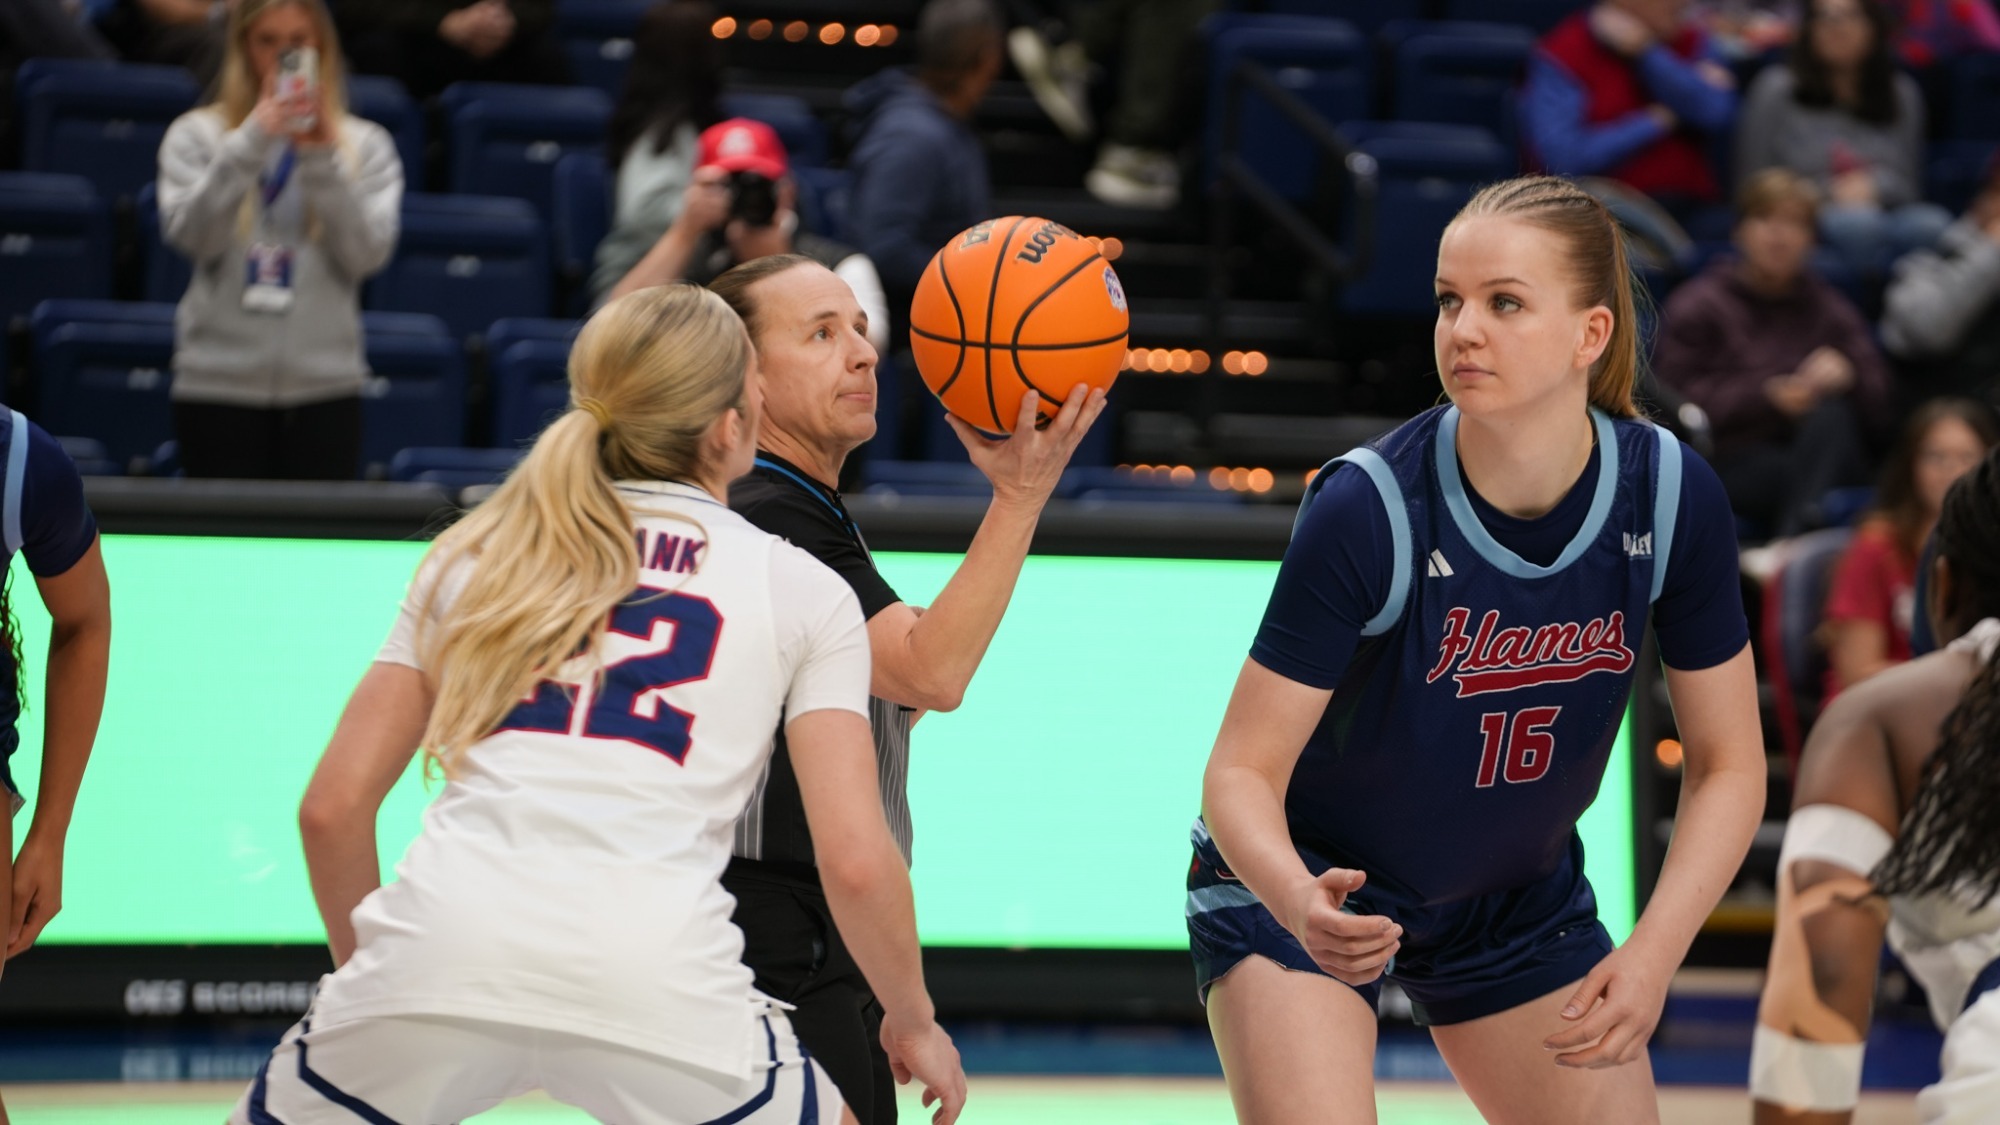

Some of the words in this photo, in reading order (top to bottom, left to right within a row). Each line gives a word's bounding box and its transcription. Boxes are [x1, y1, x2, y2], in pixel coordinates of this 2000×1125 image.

[1016, 221, 1080, 263] lson
[1427, 607, 1634, 692] Flames
[1475, 706, 1562, 788] 16
[192, 981, 317, 1013] SCORE
